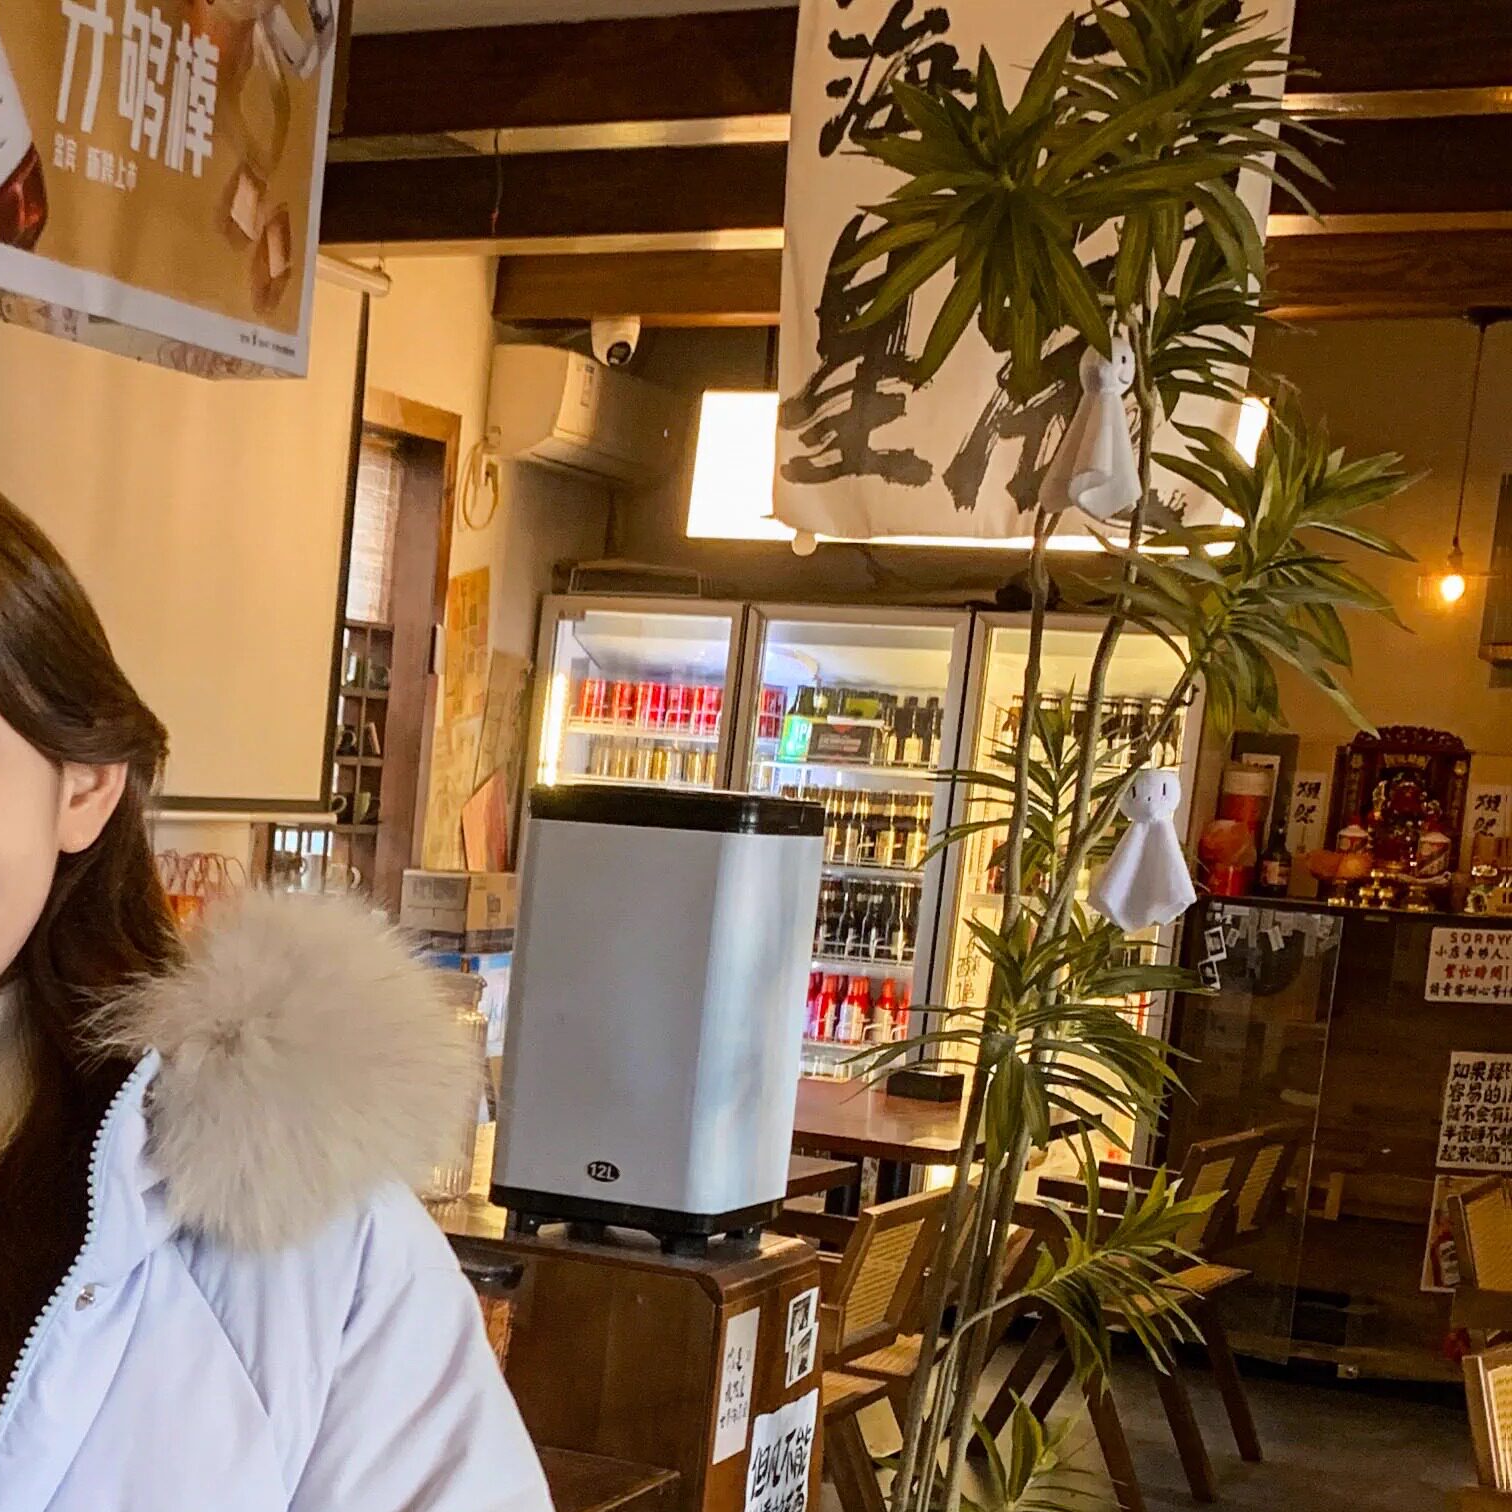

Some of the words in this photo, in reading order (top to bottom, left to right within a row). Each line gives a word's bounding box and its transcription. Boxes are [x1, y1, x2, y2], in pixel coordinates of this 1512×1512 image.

[1449, 1081, 1508, 1104] 容易的
[590, 1163, 616, 1180] 12L
